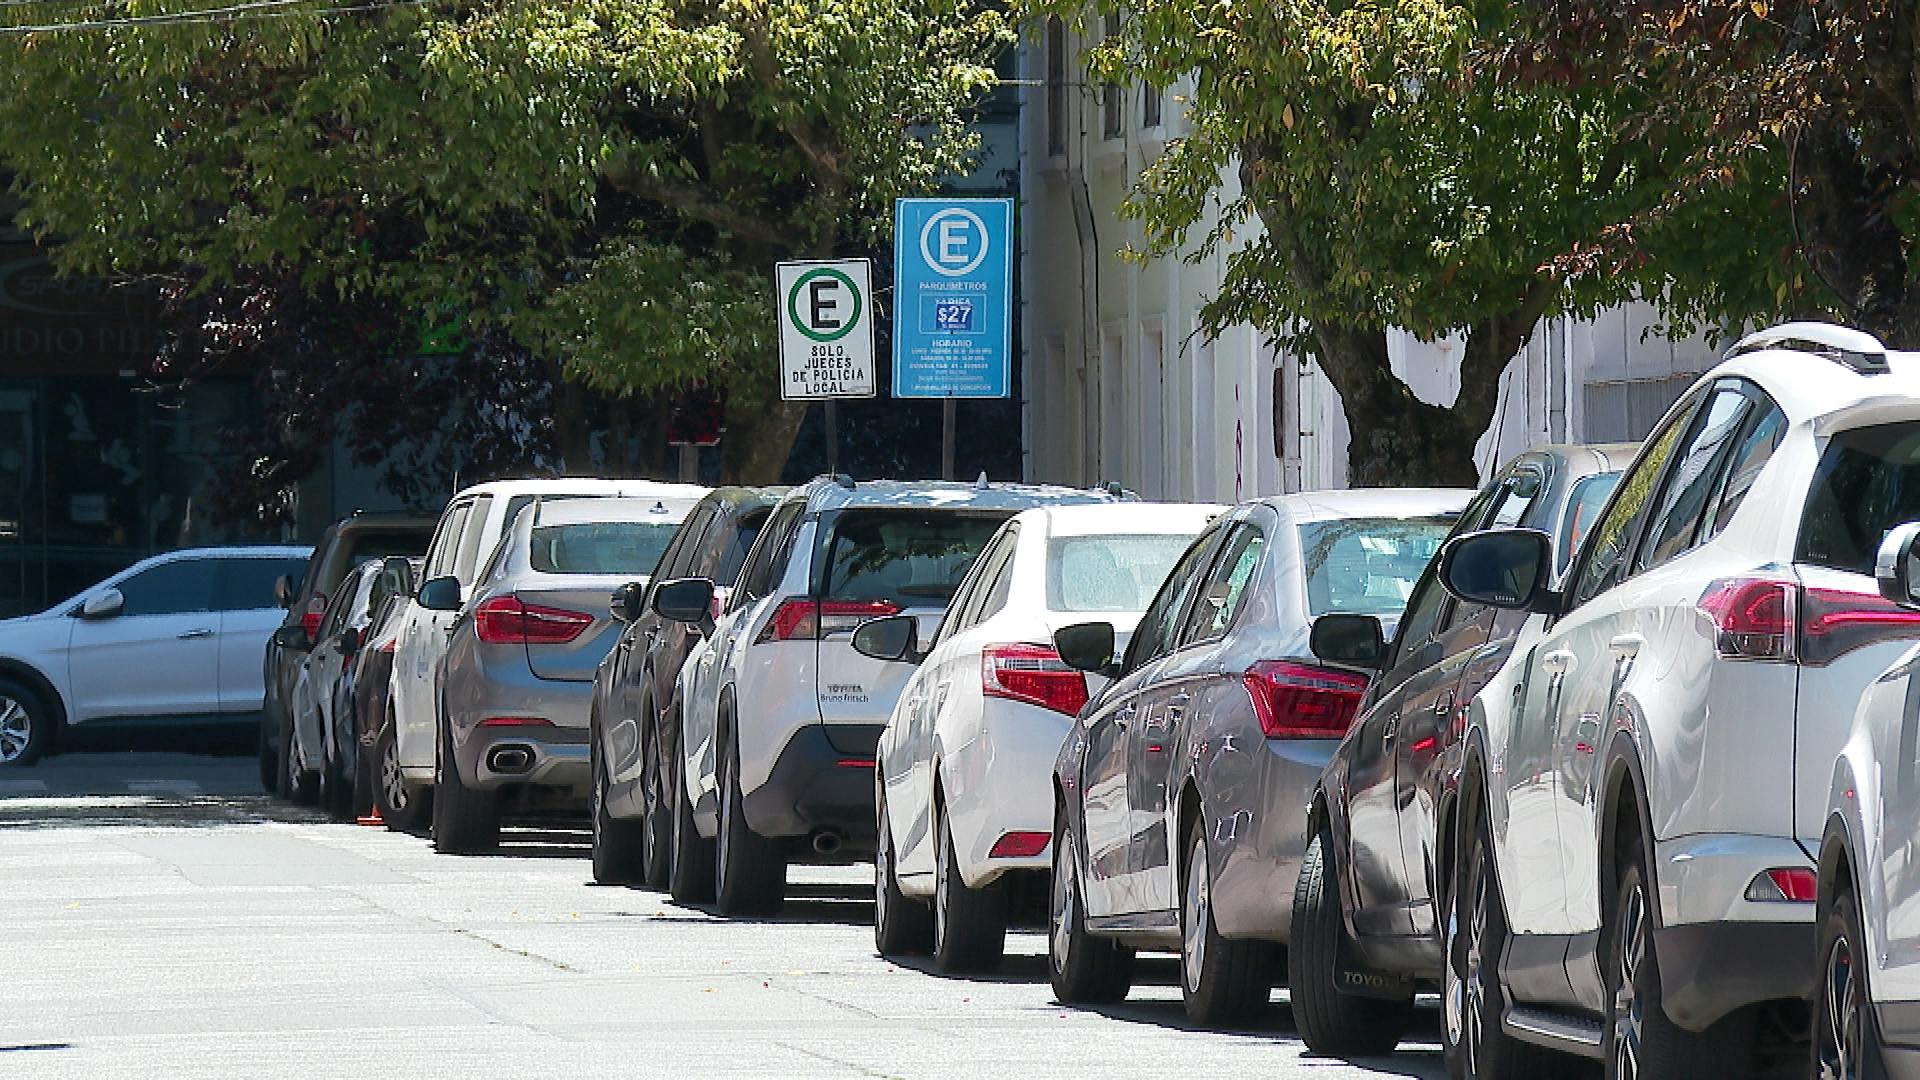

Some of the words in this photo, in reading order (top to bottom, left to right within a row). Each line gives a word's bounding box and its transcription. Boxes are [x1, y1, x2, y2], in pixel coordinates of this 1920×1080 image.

[940, 220, 969, 262] E
[810, 281, 841, 328] E
[938, 306, 971, 322] $27
[811, 346, 843, 357] SOLO
[804, 358, 852, 369] JUECES
[793, 371, 806, 382] DE
[814, 369, 864, 381] POLICIA
[806, 381, 846, 394] LOCAL
[827, 684, 863, 692] TOYOTA
[821, 694, 843, 702] Bruno
[1344, 971, 1386, 987] TOYO
